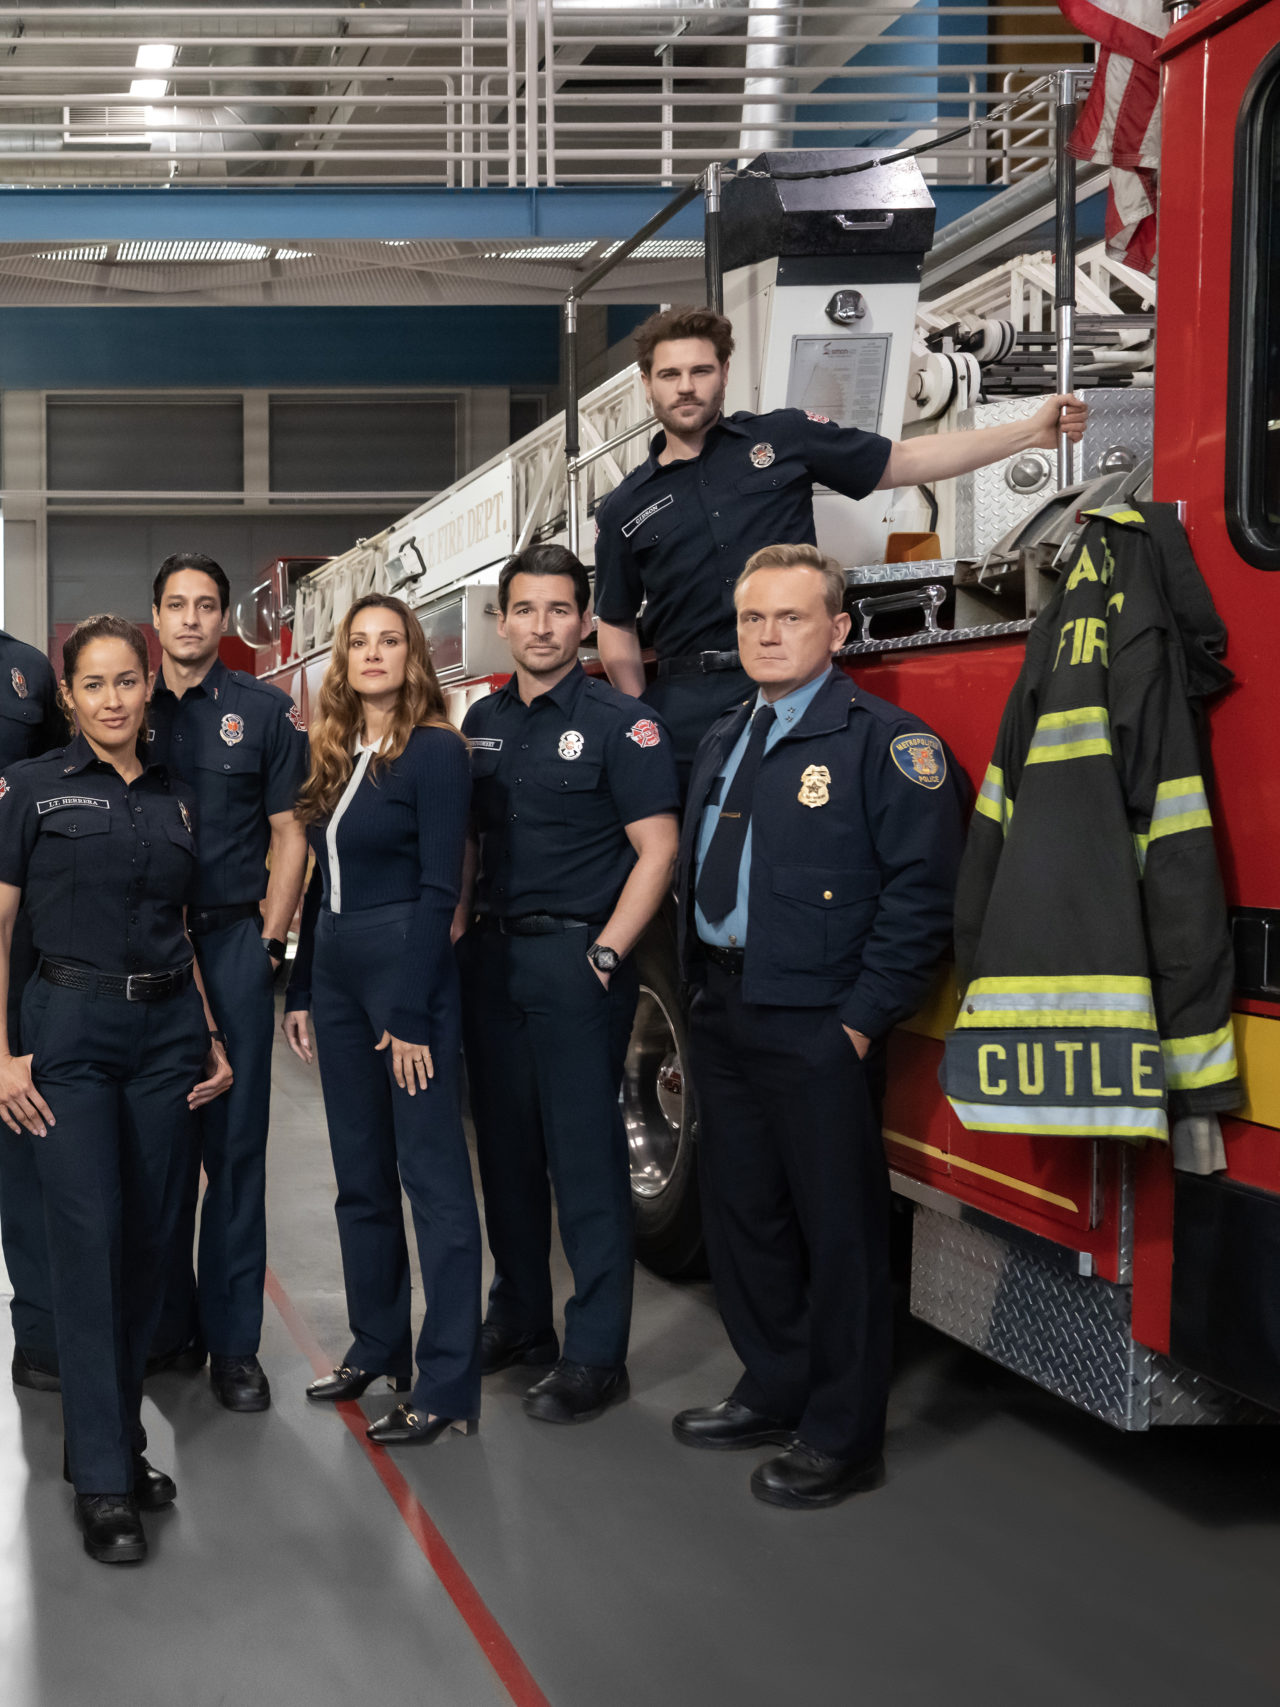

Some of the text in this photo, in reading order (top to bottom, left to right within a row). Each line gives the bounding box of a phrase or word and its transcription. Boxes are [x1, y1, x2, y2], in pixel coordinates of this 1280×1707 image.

[437, 514, 464, 565] FIRE
[467, 490, 508, 548] DEPT.
[918, 775, 939, 783] POLICE
[62, 798, 99, 806] HERRERA
